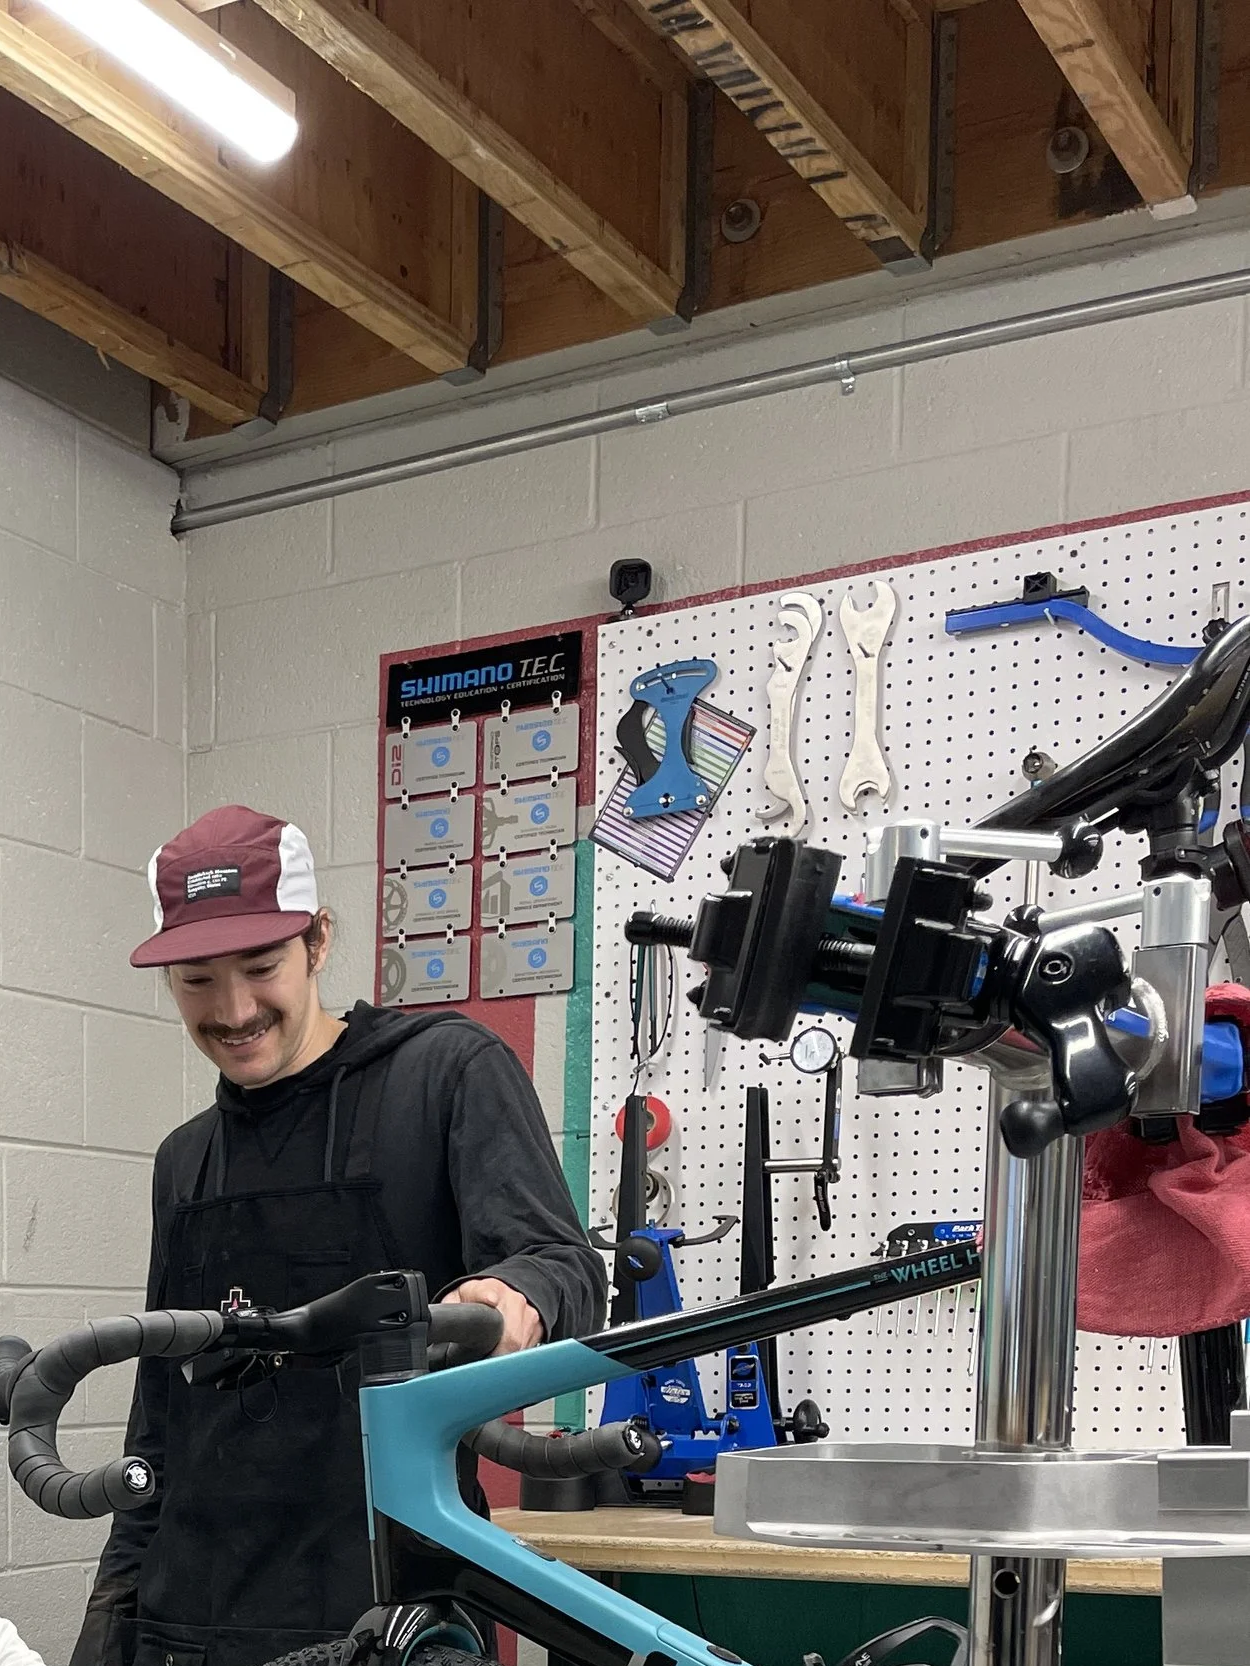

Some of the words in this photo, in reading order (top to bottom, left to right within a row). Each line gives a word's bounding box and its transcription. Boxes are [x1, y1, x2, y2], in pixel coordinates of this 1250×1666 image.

[400, 693, 451, 708] TECHNOLOGY
[453, 686, 498, 700] EDUCATION
[506, 673, 566, 690] CERTIFICATION
[401, 662, 513, 699] SHIMANO
[519, 652, 566, 678] T.E.C.
[890, 1253, 963, 1284] WHEEL
